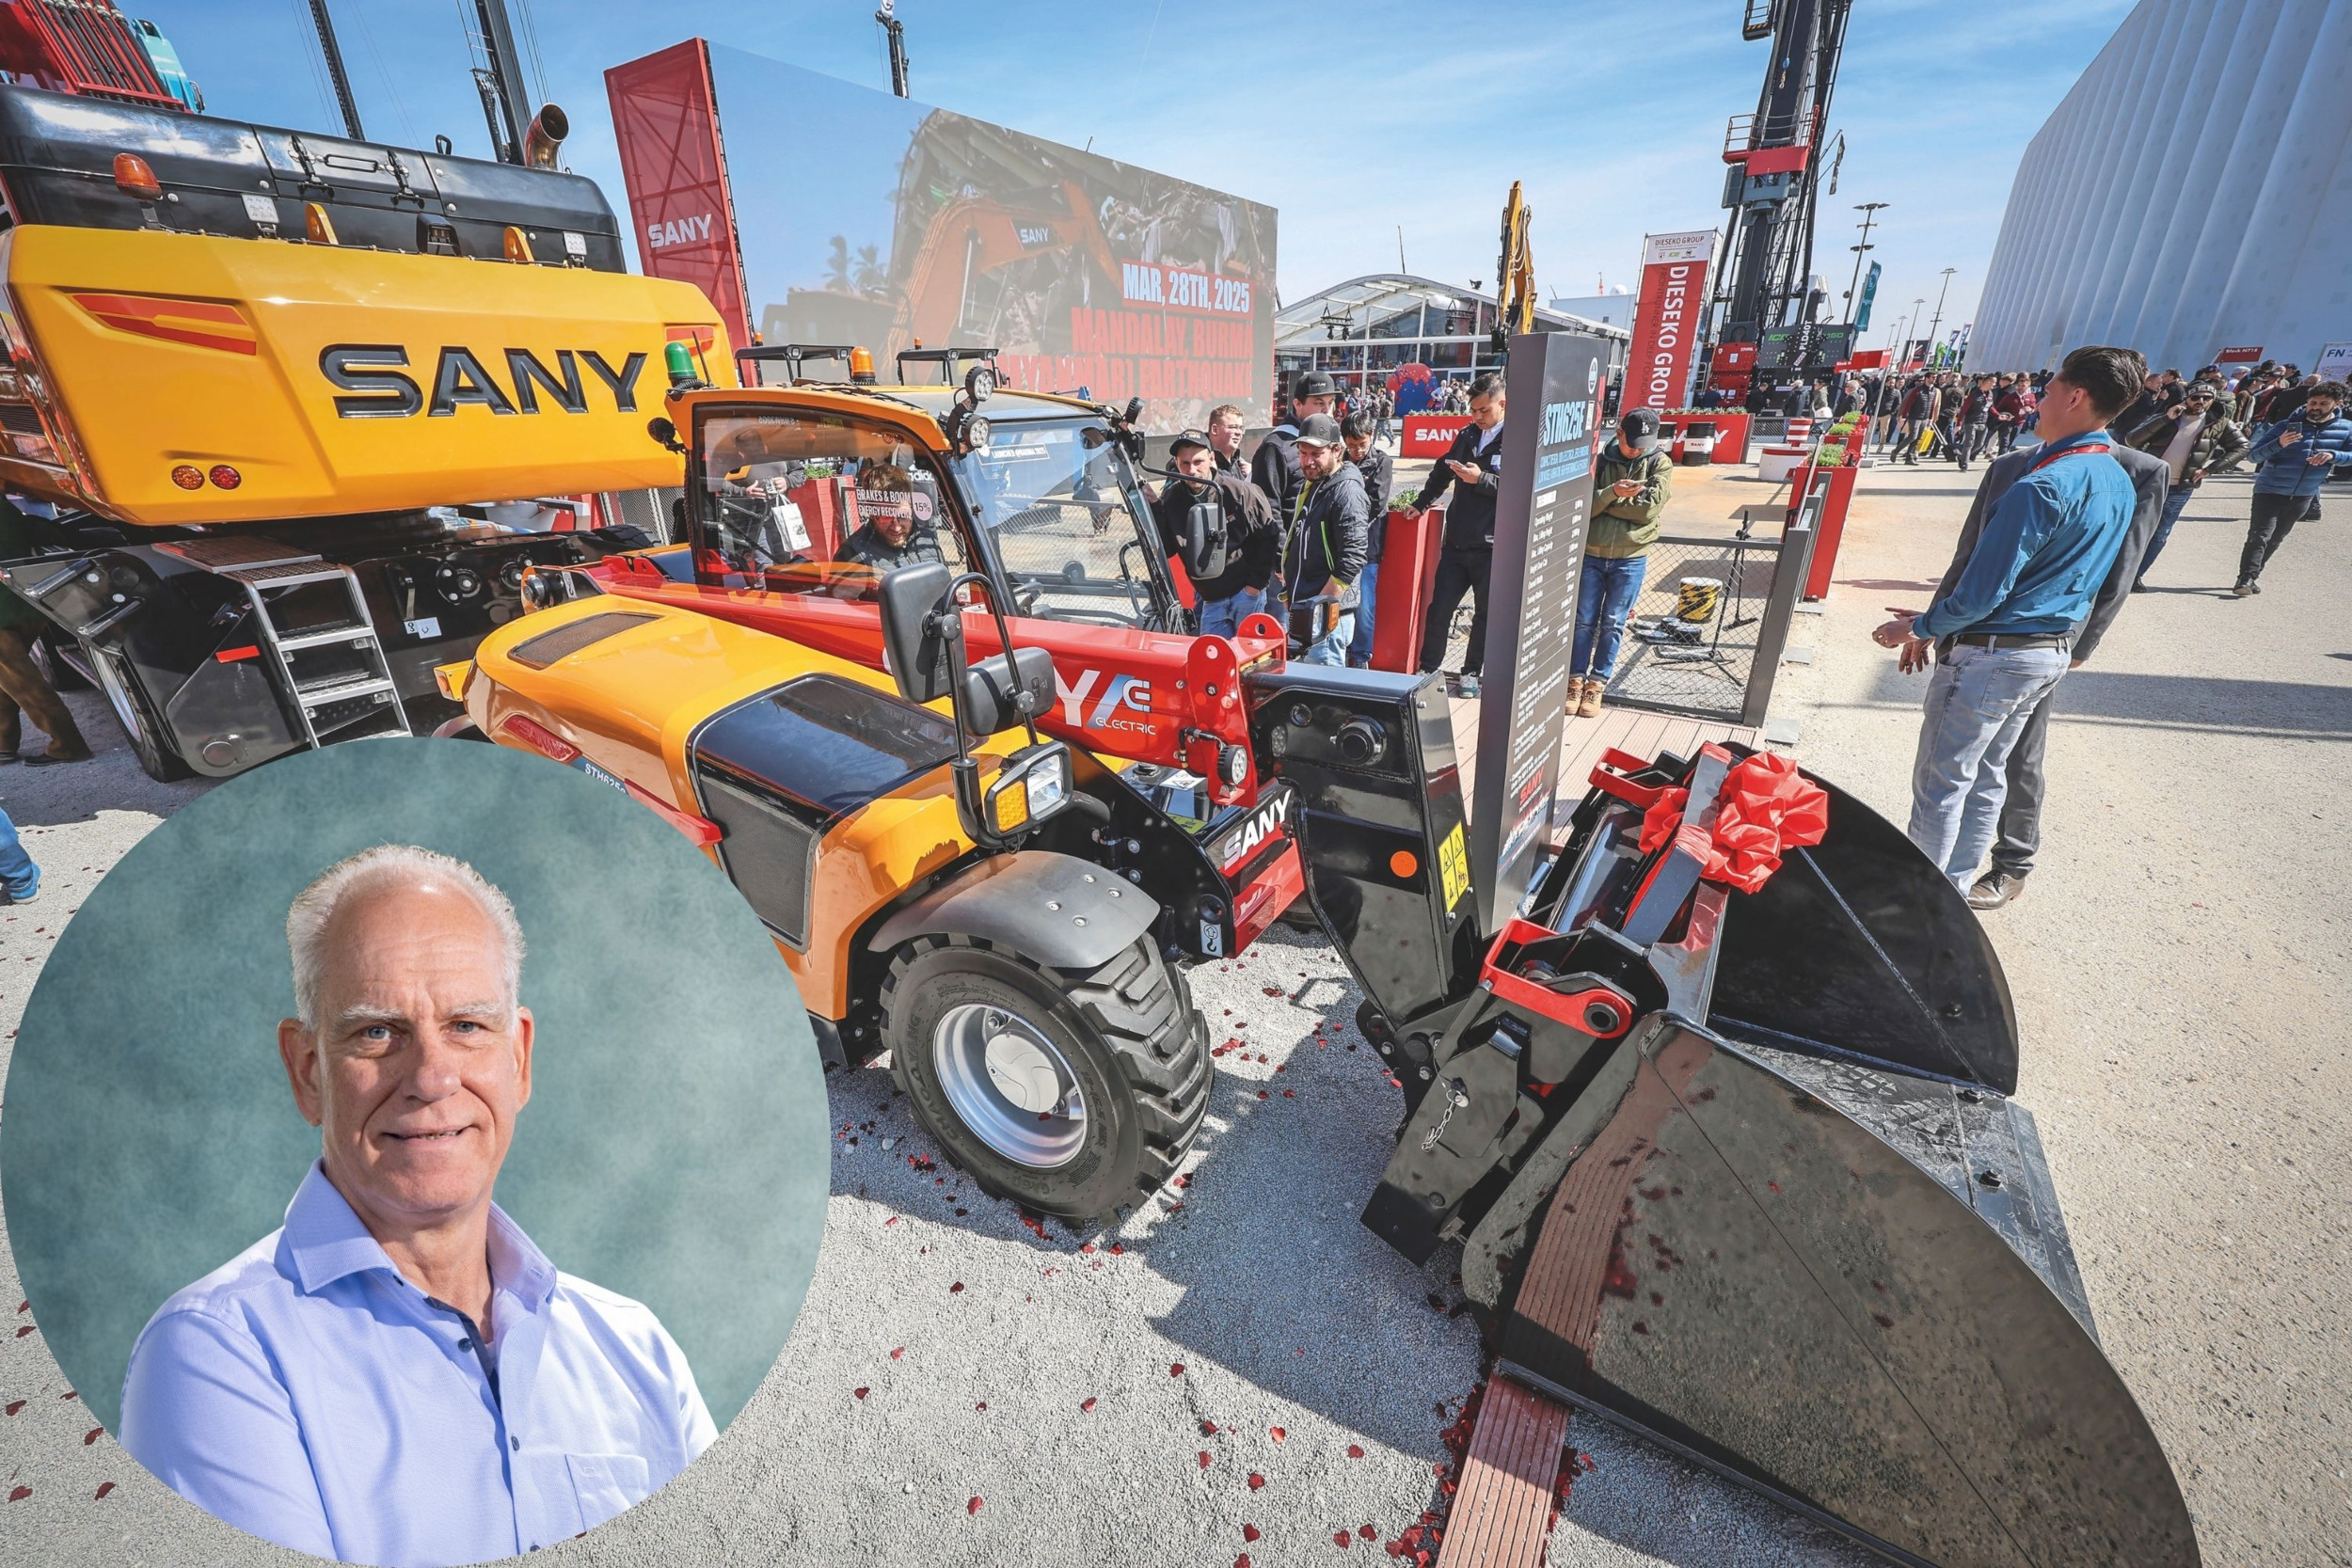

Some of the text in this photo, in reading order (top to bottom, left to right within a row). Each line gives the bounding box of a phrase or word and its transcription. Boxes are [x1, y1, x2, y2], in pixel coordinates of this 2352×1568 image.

[648, 214, 712, 248] SANY
[1020, 228, 1050, 245] SANY
[1123, 263, 1250, 313] MAR, 28TH, 2025
[1658, 266, 1689, 348] DIESEKO
[1071, 307, 1254, 359] MANDALAY, BURMA
[1799, 320, 1813, 351] PLD40T
[2327, 349, 2346, 357] FN
[320, 343, 648, 419] SANY
[1139, 358, 1254, 402] EARTHQUAKE
[1648, 353, 1674, 414] GROU
[1543, 401, 1586, 447] STH625E
[856, 489, 912, 503] BRAKES & BOOM
[858, 505, 881, 516] ENERGY
[914, 502, 931, 513] 15%
[1095, 717, 1156, 735] ELECTRIC
[1519, 766, 1544, 806] SANY
[1224, 788, 1292, 870] SANY
